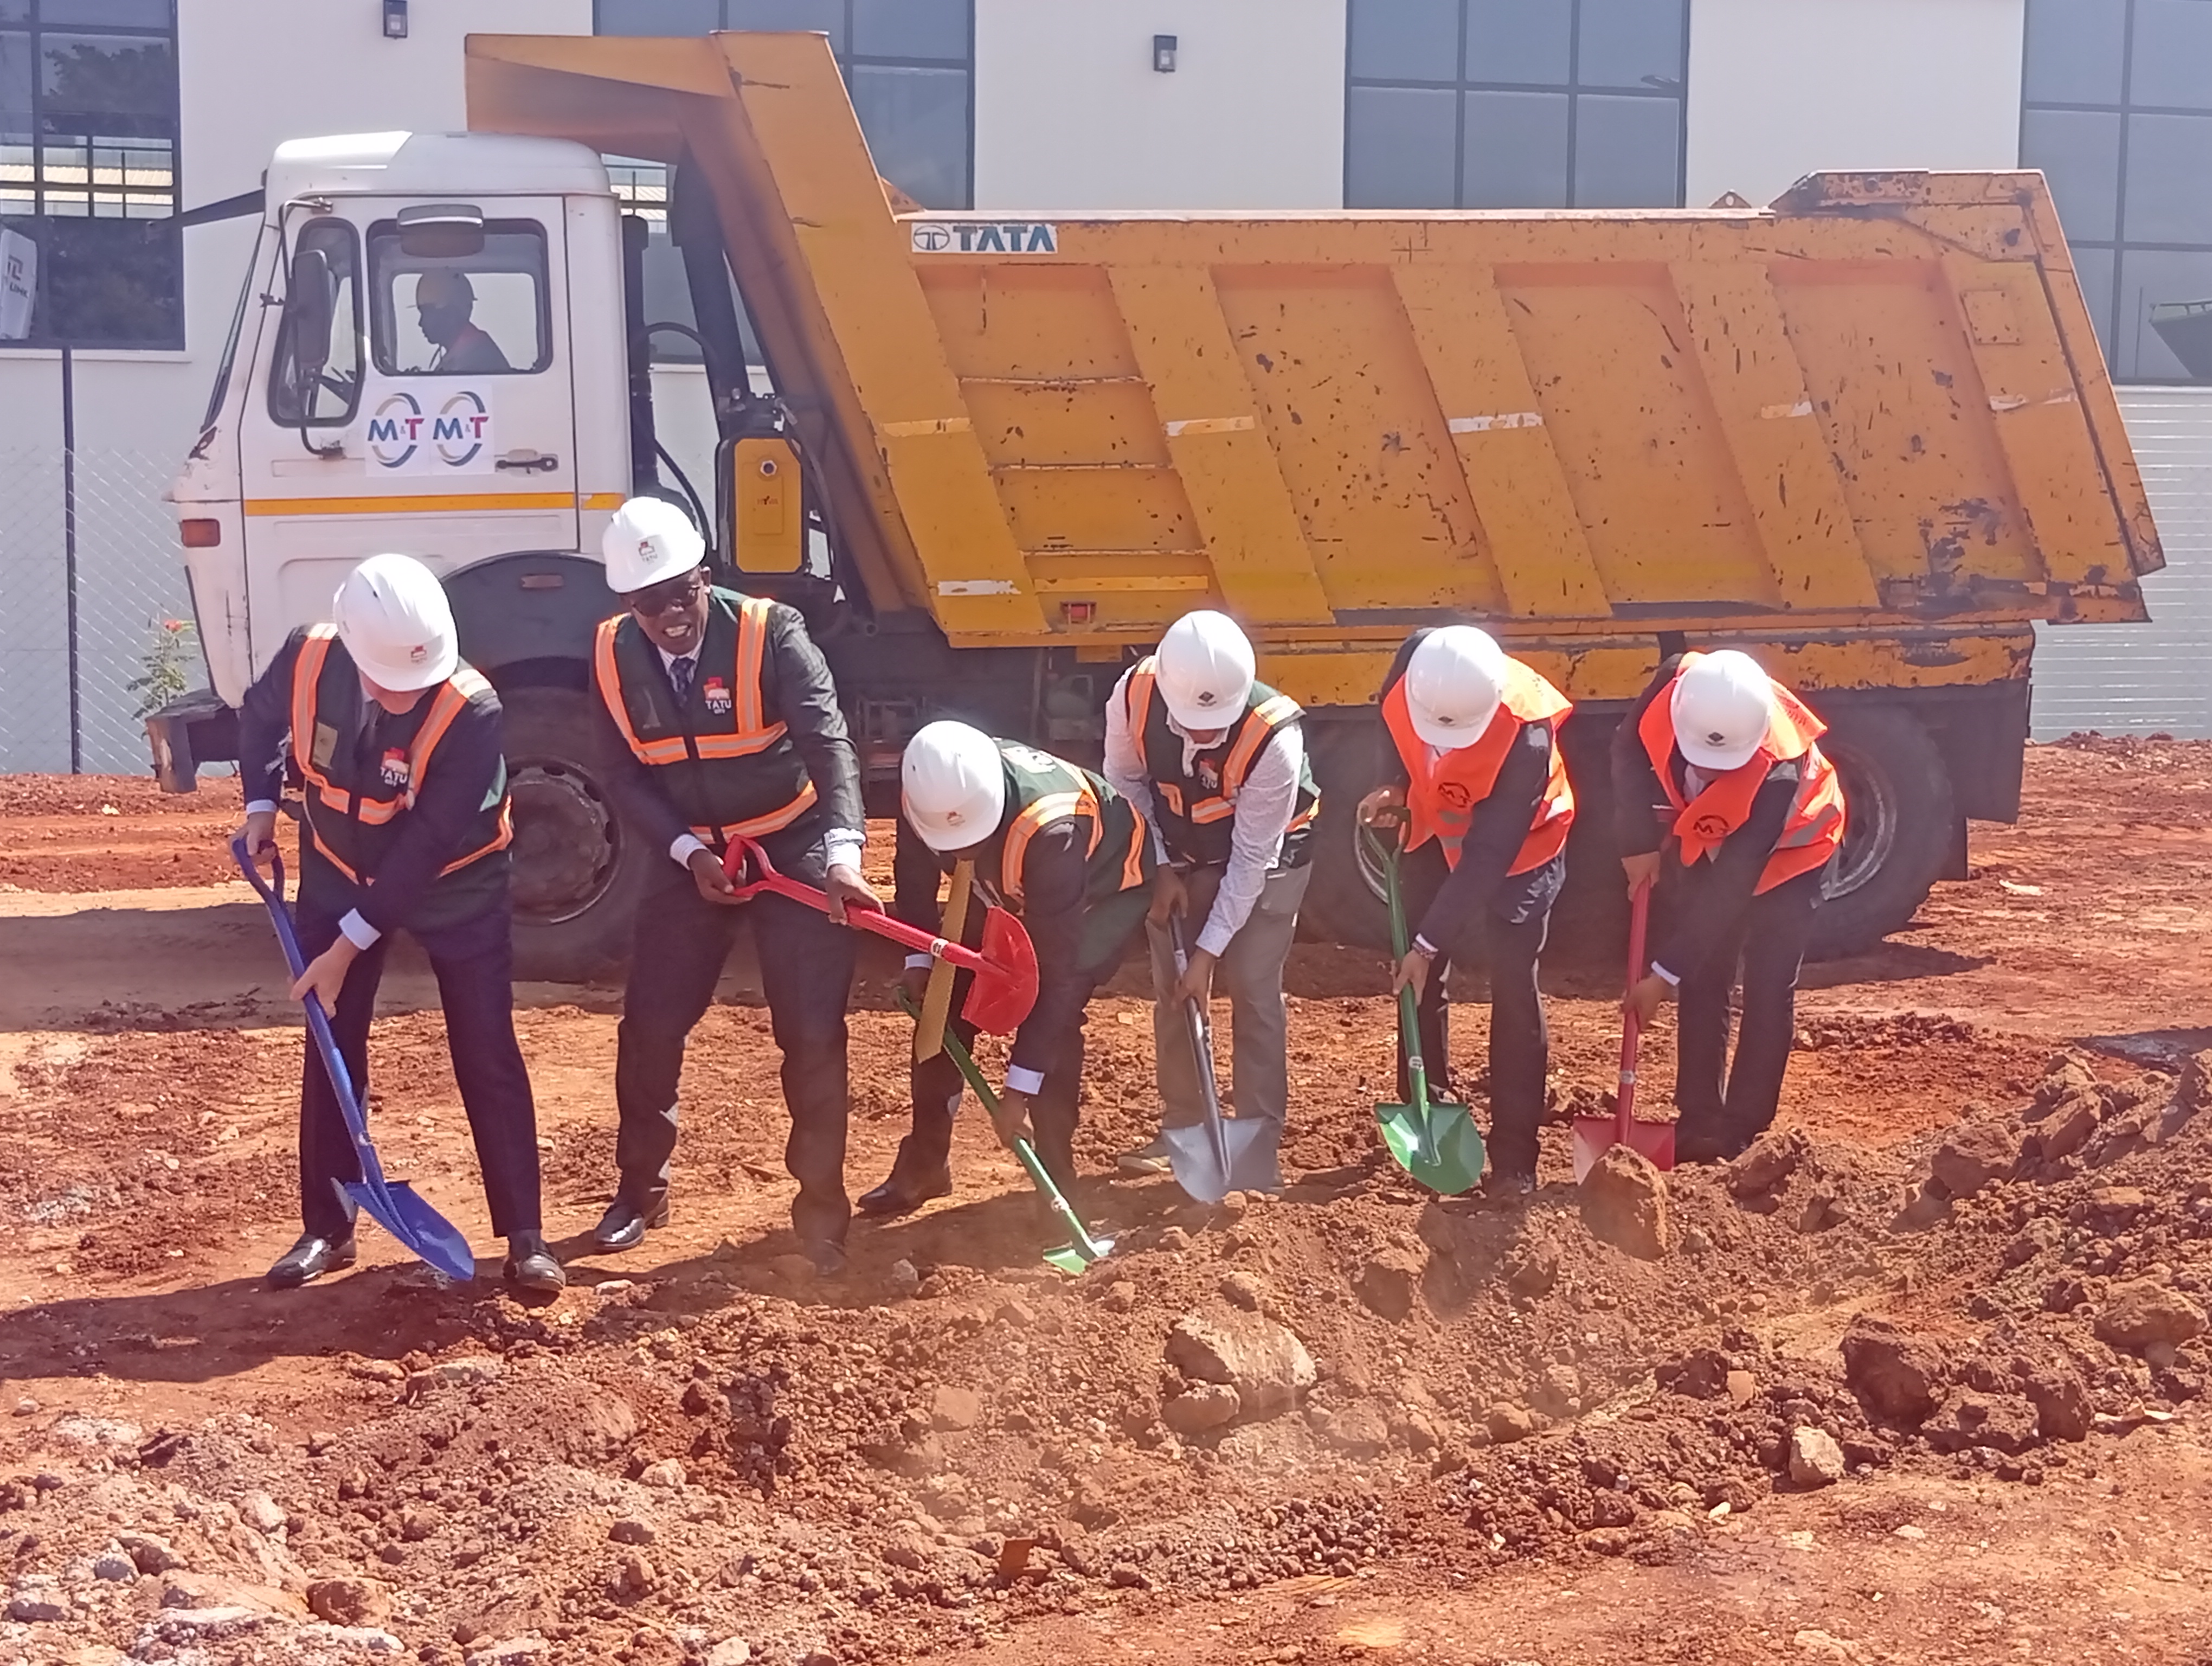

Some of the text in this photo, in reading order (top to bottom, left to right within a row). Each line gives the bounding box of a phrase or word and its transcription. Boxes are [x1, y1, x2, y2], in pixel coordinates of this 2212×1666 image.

[953, 225, 1056, 252] TATA
[368, 418, 425, 441] M&T
[433, 416, 489, 440] M&T
[705, 699, 731, 710] TATU
[380, 766, 408, 783] TATU
